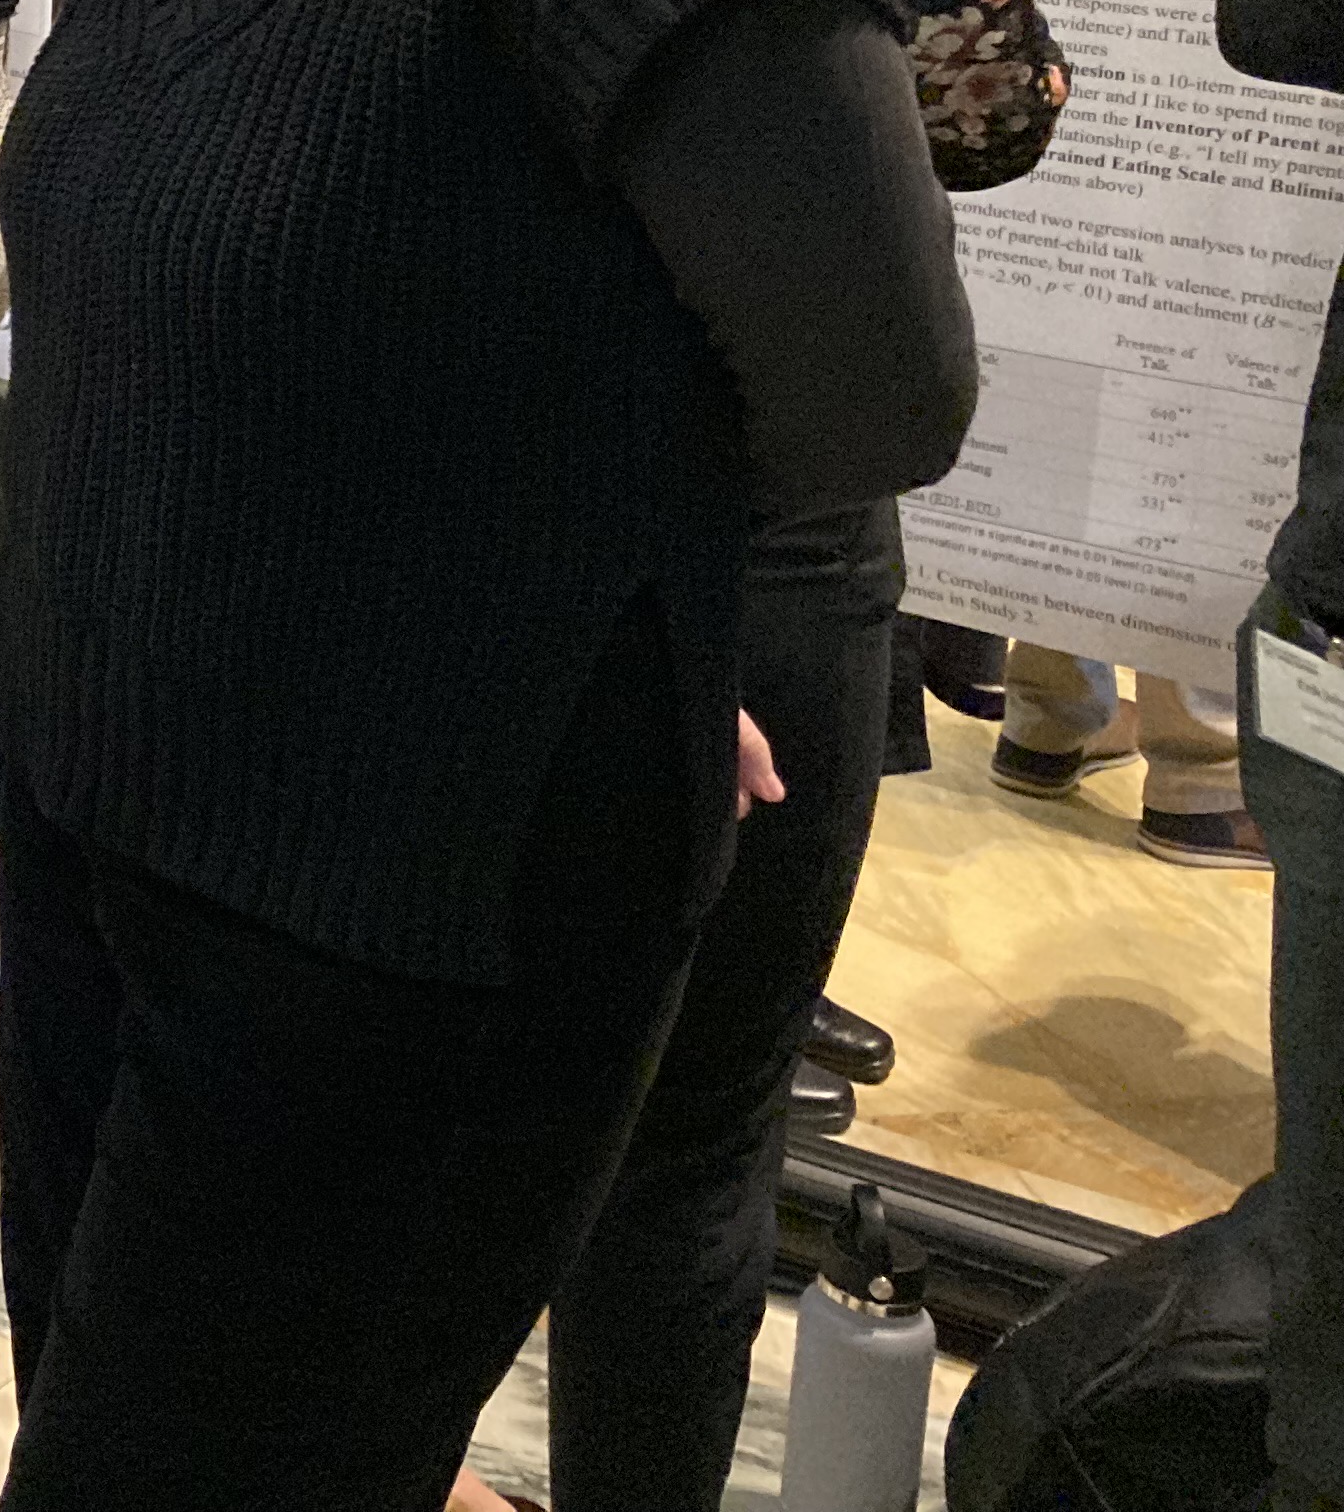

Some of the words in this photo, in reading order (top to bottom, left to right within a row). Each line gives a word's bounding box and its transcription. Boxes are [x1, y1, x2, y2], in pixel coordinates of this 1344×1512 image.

[1154, 7, 1198, 22] were
[1136, 27, 1170, 42] and
[1175, 28, 1212, 47] Talk
[1240, 86, 1316, 106] measure
[1215, 105, 1268, 123] spend
[1273, 111, 1313, 129] time
[1135, 114, 1227, 143] Inventory
[1232, 128, 1254, 143] of
[1257, 130, 1321, 153] Parent
[1219, 149, 1248, 166] tell
[1253, 156, 1281, 174] my
[1111, 156, 1172, 181] Eating
[1177, 165, 1226, 185] Scale
[1231, 176, 1264, 191] and
[1270, 178, 1344, 203] Bulimia
[951, 202, 1037, 224] conducted
[1041, 213, 1074, 229] two
[1078, 220, 1165, 245] regression
[1169, 235, 1245, 257] analyses
[1250, 245, 1268, 260] to
[1271, 251, 1335, 271] predict
[1113, 247, 1144, 264] talk
[1056, 256, 1085, 275] but
[1089, 266, 1116, 281] not
[1121, 268, 1157, 288] Talk
[1164, 278, 1236, 302] valence,
[1241, 291, 1325, 315] predicted
